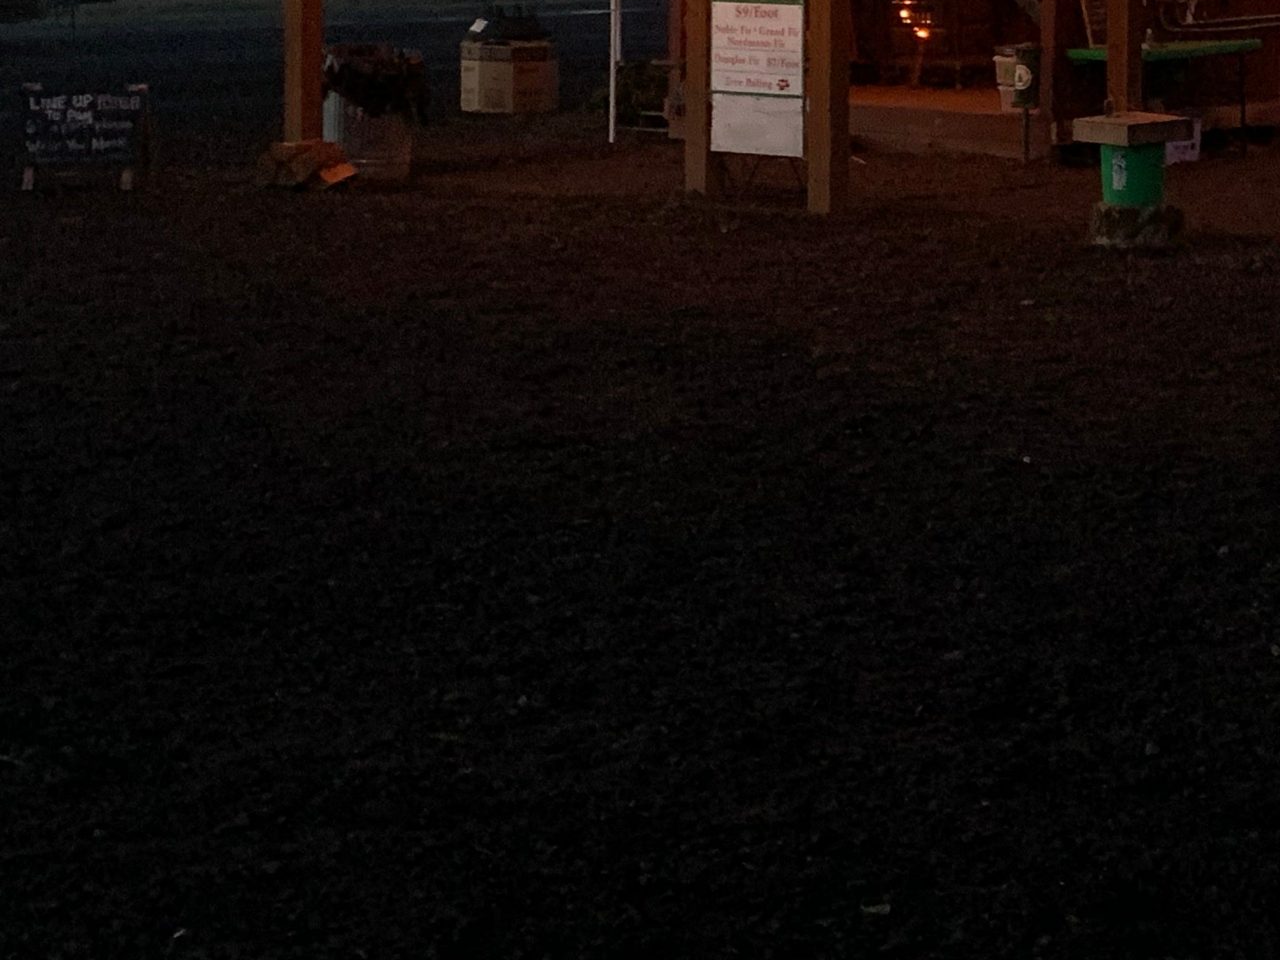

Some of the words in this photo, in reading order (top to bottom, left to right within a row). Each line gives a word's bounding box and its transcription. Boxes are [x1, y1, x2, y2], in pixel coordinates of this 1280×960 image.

[735, 5, 779, 19] $9/Foot
[29, 95, 67, 110] LINE
[72, 93, 94, 108] UP
